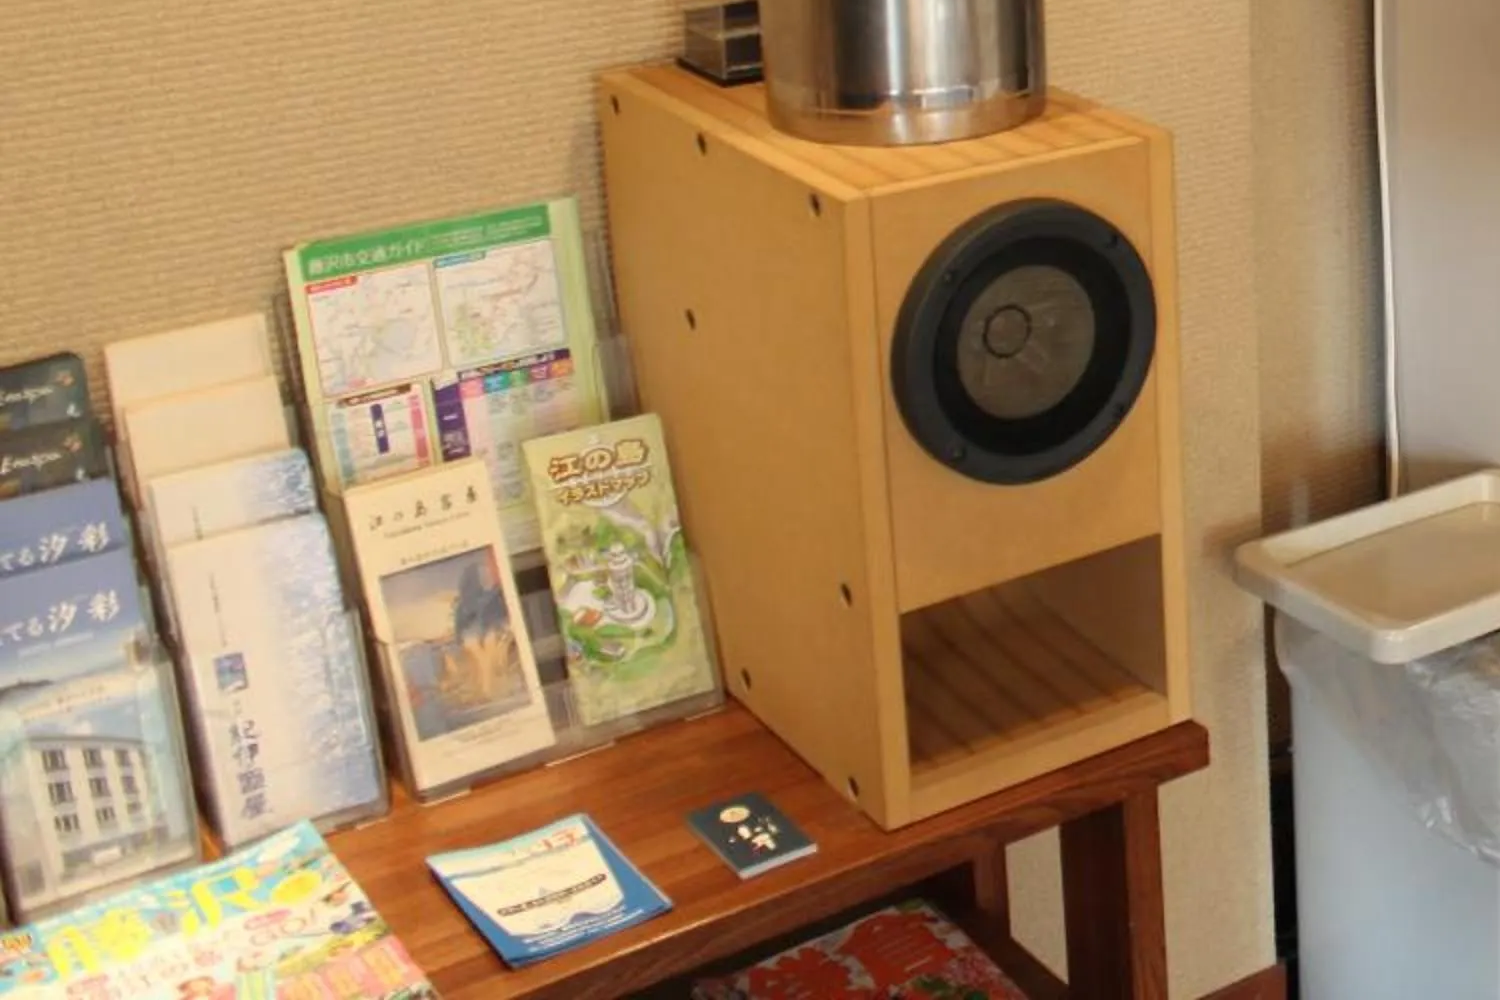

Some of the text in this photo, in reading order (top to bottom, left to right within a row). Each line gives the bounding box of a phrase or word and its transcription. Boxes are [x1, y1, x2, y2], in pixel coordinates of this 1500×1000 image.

[548, 438, 650, 484] 江の島
[557, 468, 651, 506] イラストマップ
[0, 588, 121, 645] てる汐彩
